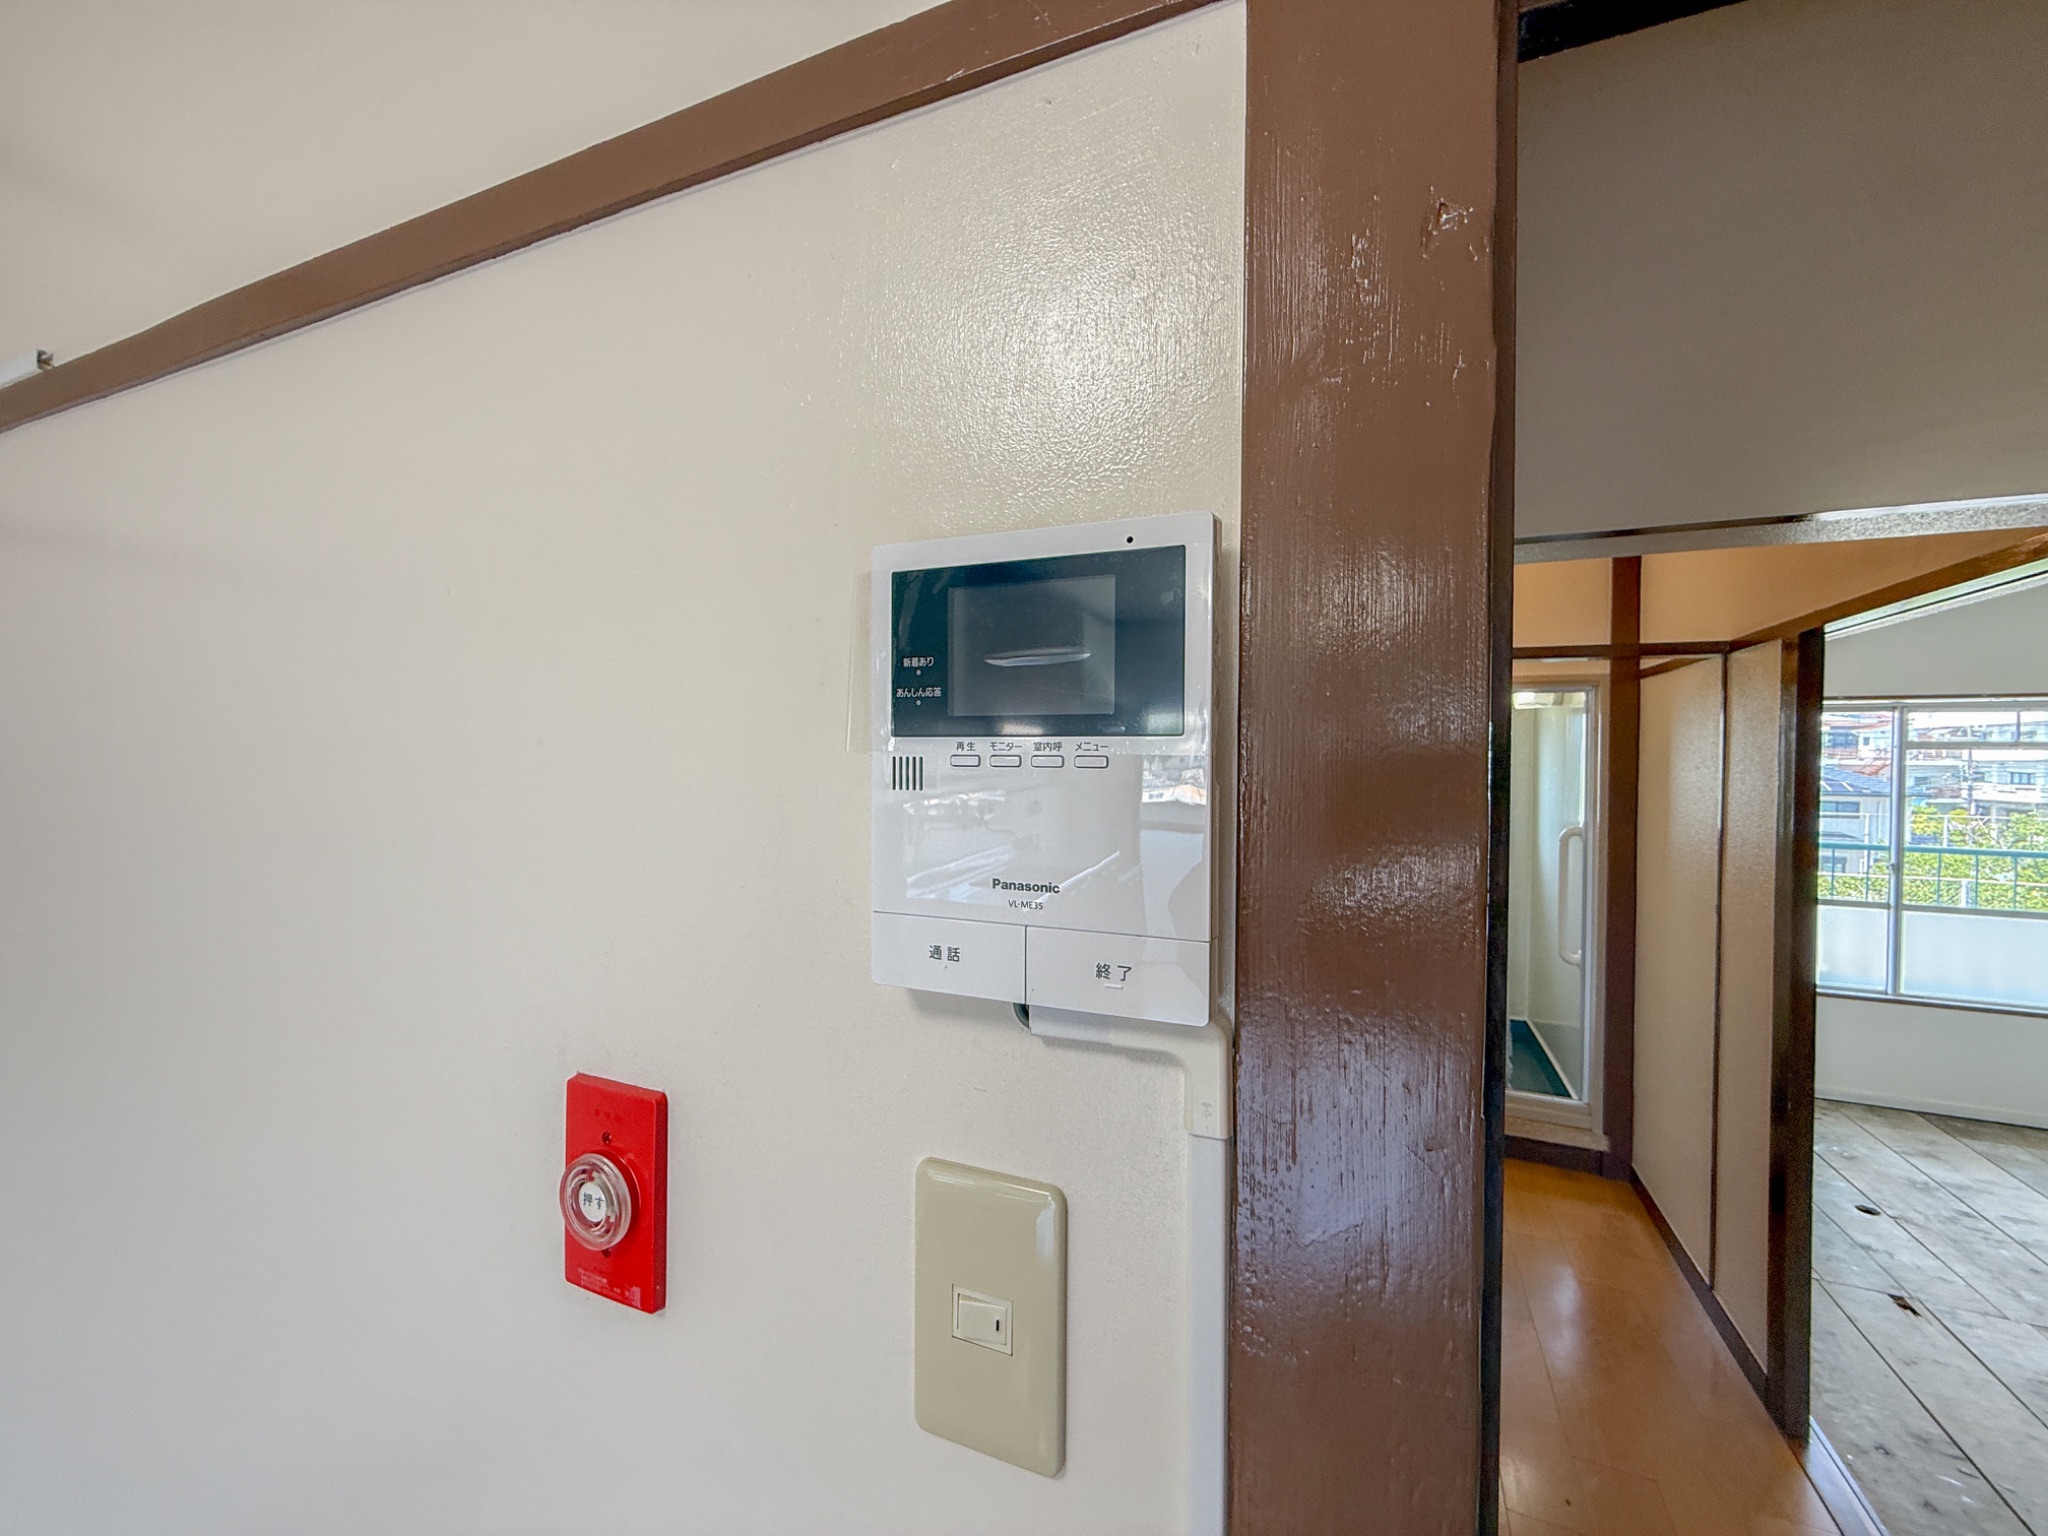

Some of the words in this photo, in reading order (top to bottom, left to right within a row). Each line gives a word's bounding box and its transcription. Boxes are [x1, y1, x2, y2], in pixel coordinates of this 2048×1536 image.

[903, 657, 934, 667] 新着あり
[896, 687, 942, 698] あんしん応答
[956, 742, 976, 752] 再生
[990, 742, 1022, 751] モニター
[1033, 742, 1063, 752] 室内呼
[1075, 742, 1109, 752] メニュー
[992, 878, 1060, 894] Panasonic
[1008, 900, 1043, 910] VL-ME35
[929, 945, 961, 962] 通話
[1095, 962, 1132, 981] 終了
